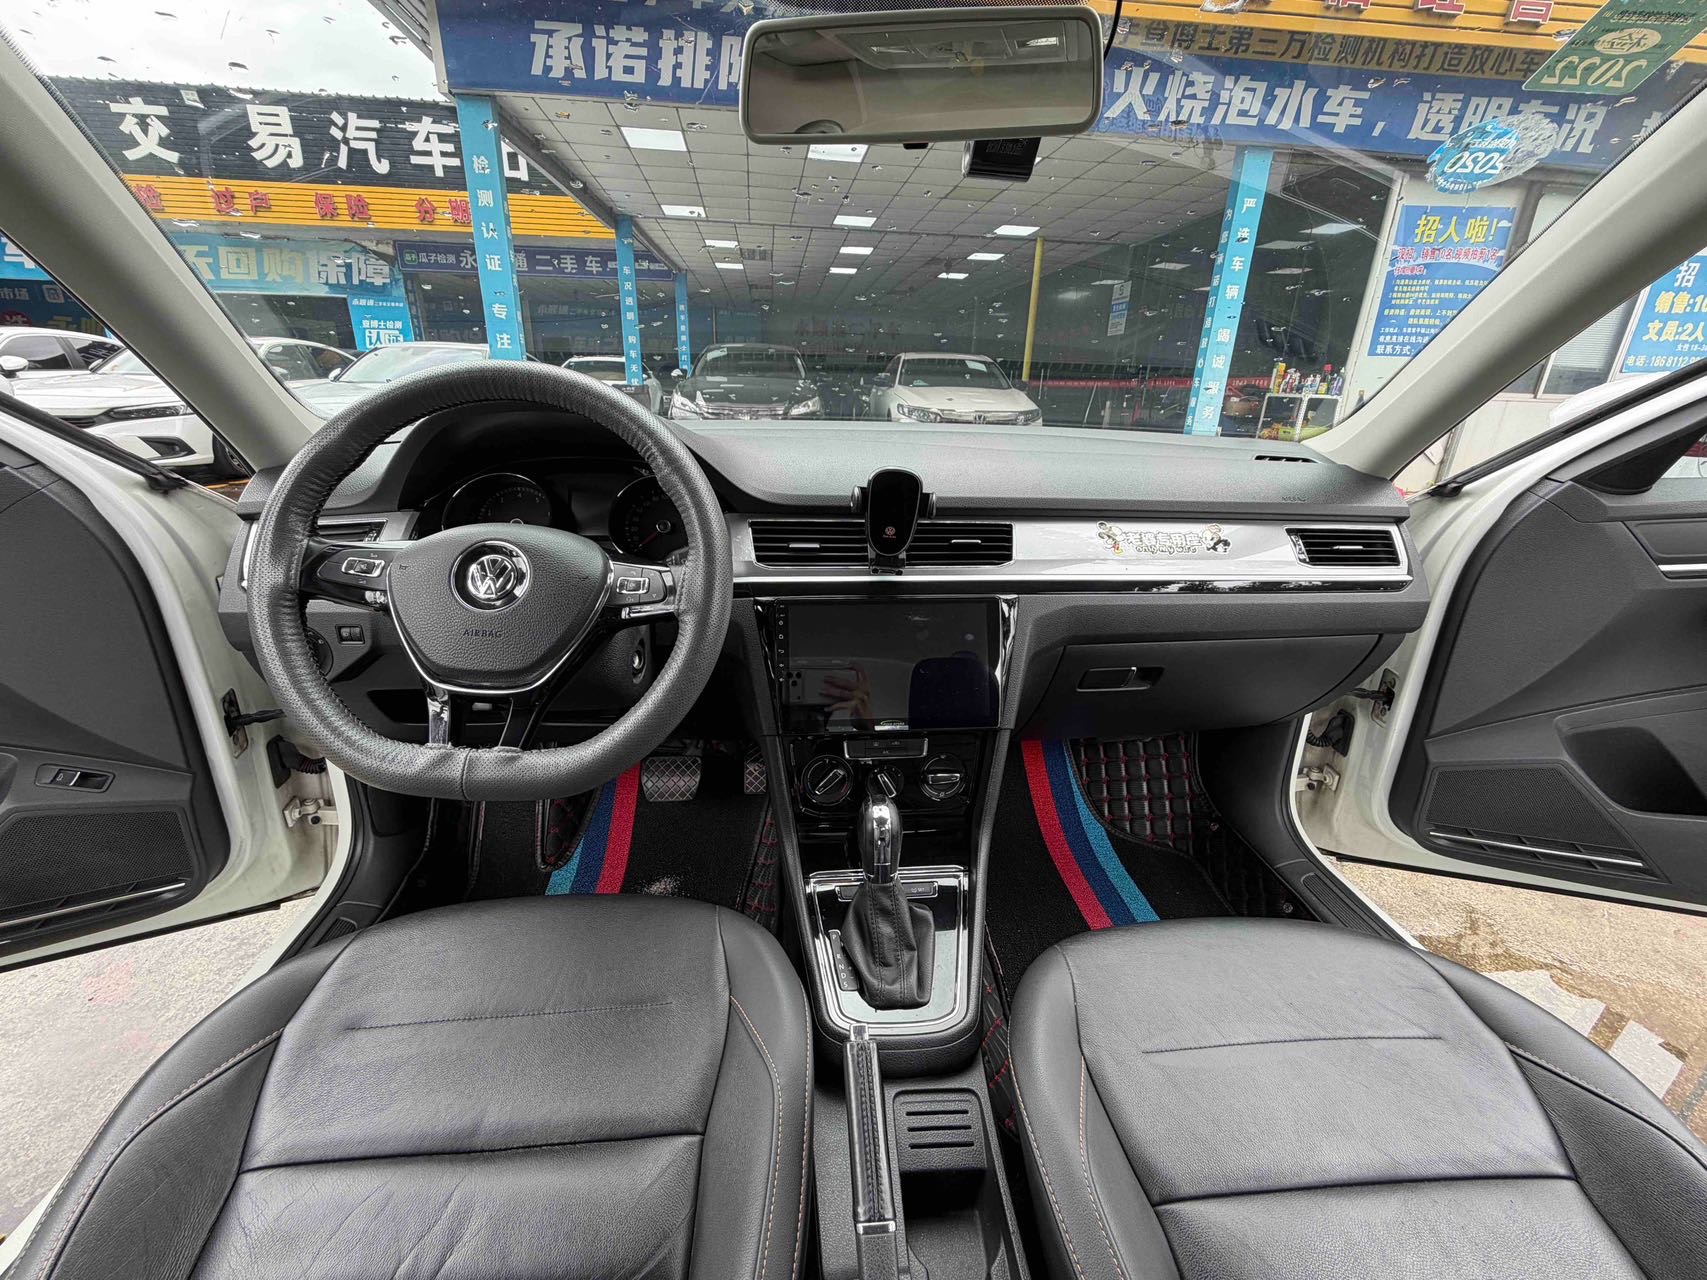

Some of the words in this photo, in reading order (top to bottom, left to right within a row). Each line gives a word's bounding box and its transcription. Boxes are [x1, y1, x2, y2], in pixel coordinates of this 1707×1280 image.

[314, 192, 372, 219] 保险
[418, 252, 457, 264] 瓜子检测
[471, 154, 503, 272] 检测认证
[491, 303, 513, 349] 专注
[462, 628, 502, 638] AIRBAG
